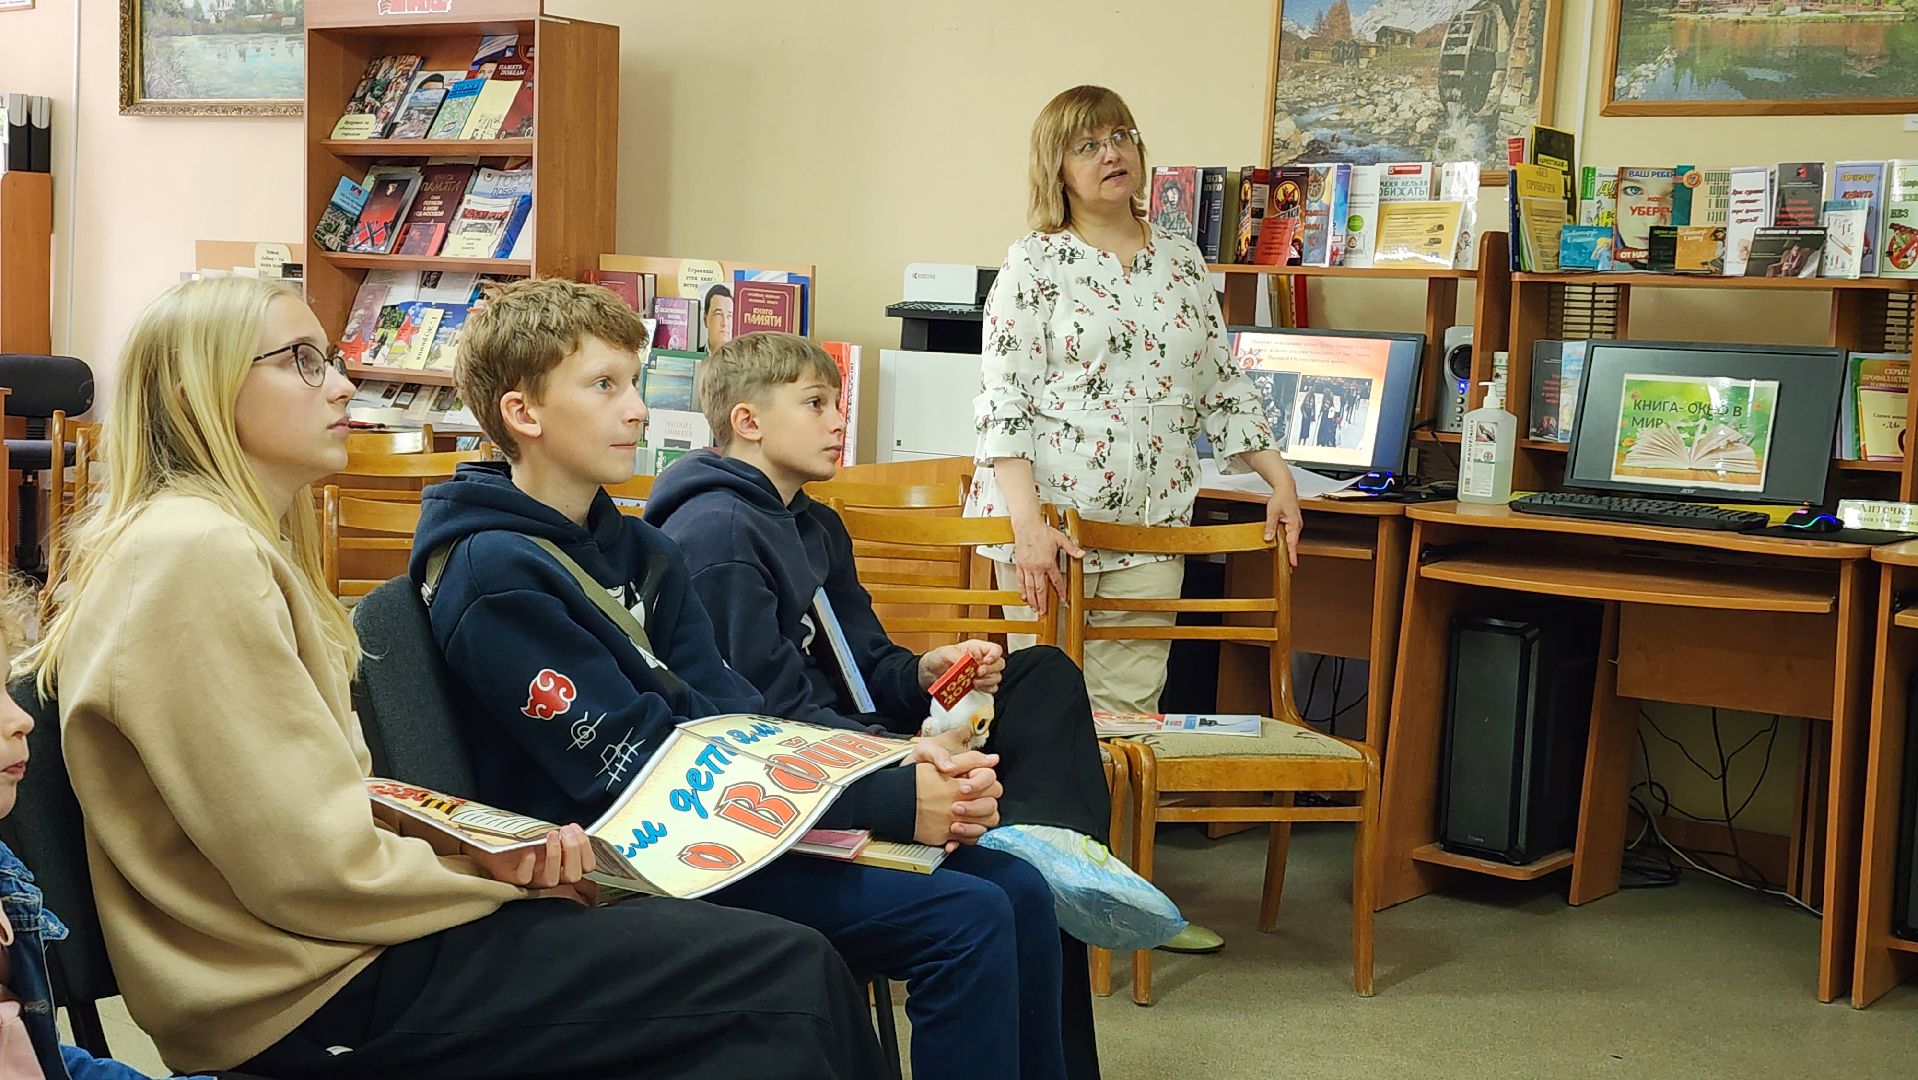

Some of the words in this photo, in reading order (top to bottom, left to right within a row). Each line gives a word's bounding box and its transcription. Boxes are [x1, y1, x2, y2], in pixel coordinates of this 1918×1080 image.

[1628, 170, 1649, 178] ВАШ
[743, 312, 783, 328] ПАМЯТИ
[1732, 406, 1743, 417] В
[1631, 416, 1664, 429] МИР
[676, 841, 746, 871] О
